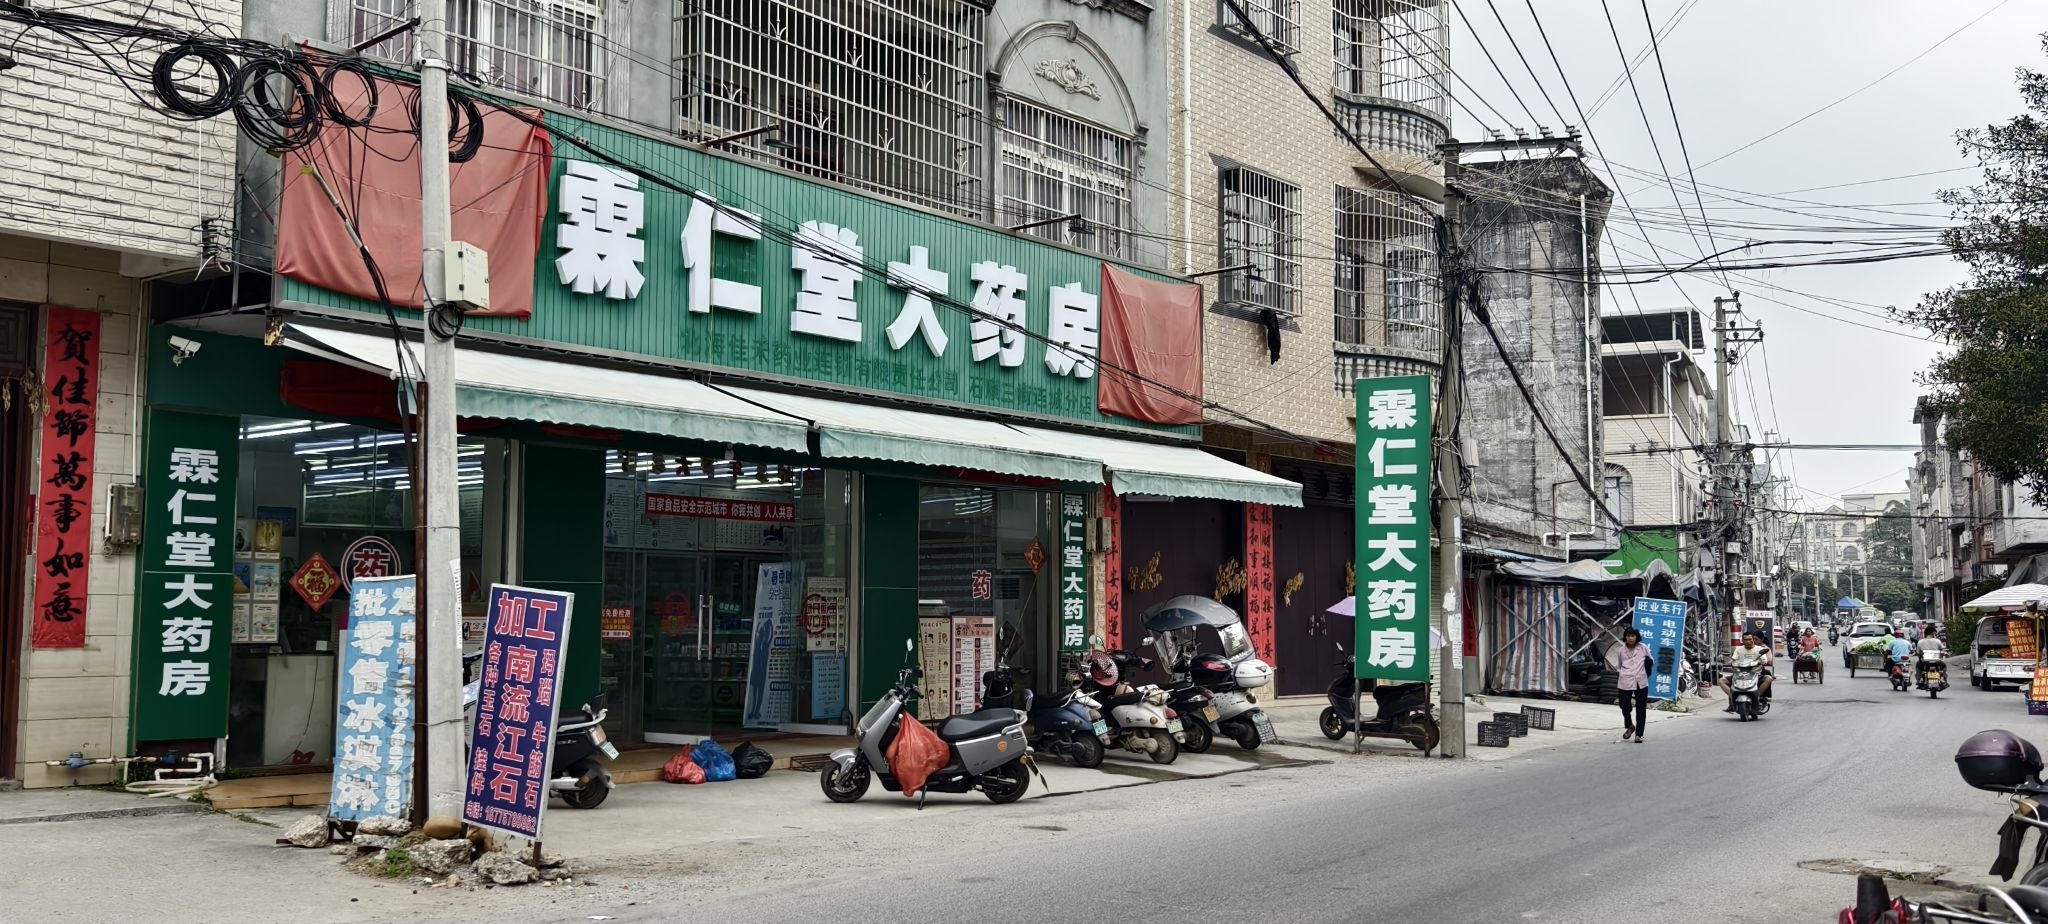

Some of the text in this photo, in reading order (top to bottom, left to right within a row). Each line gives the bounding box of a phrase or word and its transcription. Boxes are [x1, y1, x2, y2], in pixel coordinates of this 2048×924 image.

[555, 159, 1098, 378] 霖仁堂大药房
[648, 497, 794, 519] 国家食品安全示范城市 你我共创 人人共享
[1368, 389, 1417, 668] 霖仁堂大药房
[159, 447, 218, 696] 霖仁堂大药房
[353, 548, 391, 577] 药
[971, 570, 992, 600] 药
[1063, 494, 1085, 647] 霖仁堂大药房
[1637, 601, 1682, 615] 旺业车行
[494, 592, 559, 641] 加工
[490, 645, 537, 805] 南流江石
